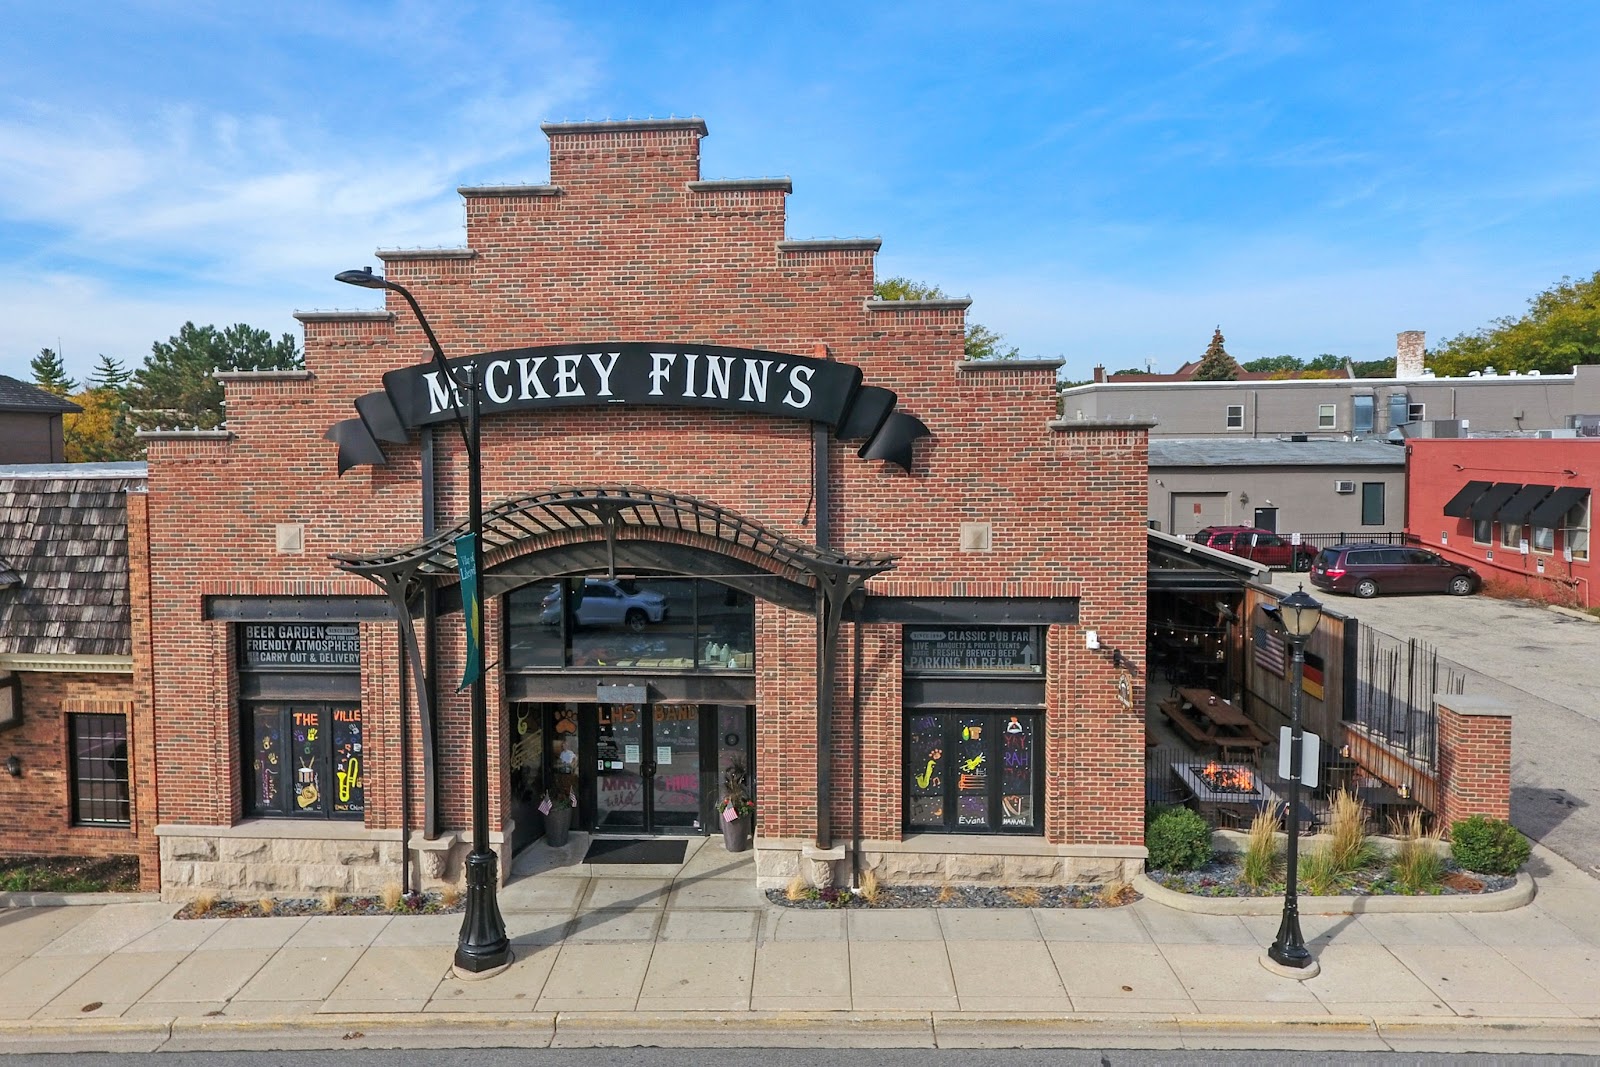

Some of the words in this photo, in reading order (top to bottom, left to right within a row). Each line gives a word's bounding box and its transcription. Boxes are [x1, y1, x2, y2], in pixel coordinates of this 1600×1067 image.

[422, 352, 622, 415] MCKEY
[648, 352, 816, 410] FINN'S
[246, 625, 275, 638] BEER
[278, 625, 325, 640] GARDEN
[947, 631, 987, 641] CLASSIC
[989, 631, 1009, 641] PUB
[246, 639, 292, 651] FRIENDLY
[295, 640, 360, 652] ATMOSPHERE
[912, 642, 929, 651] LIVE
[260, 652, 288, 662] CARRY
[290, 652, 307, 662] OUT
[309, 653, 317, 663] &
[320, 653, 360, 663] DELIVERY
[932, 649, 964, 657] FRESHLY
[966, 649, 997, 657] BREWED
[999, 650, 1017, 658] BEER
[910, 657, 961, 669] PARKING
[965, 657, 978, 670] IN
[981, 657, 1012, 670] REAR
[292, 712, 319, 726] THE
[333, 710, 361, 722] VILLE
[598, 705, 637, 725] LHS
[654, 705, 698, 721] BAND
[1005, 752, 1028, 766] RAH
